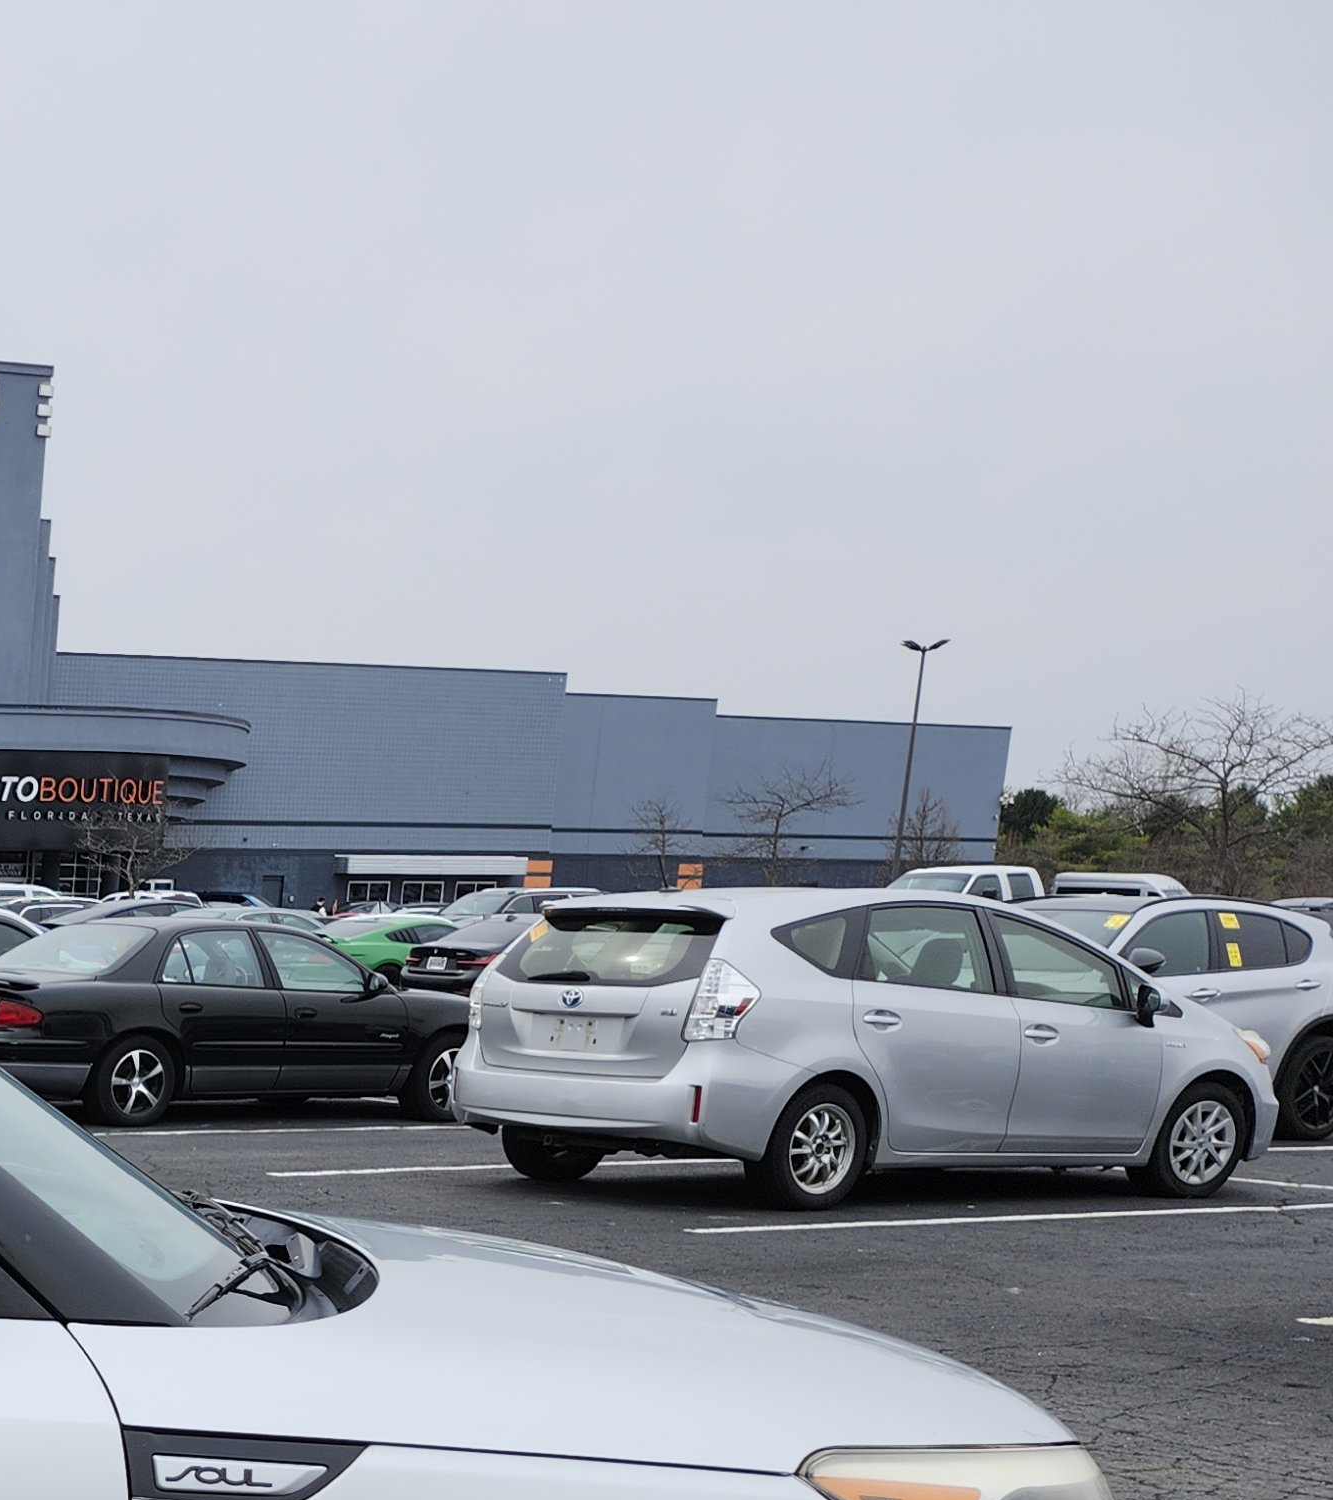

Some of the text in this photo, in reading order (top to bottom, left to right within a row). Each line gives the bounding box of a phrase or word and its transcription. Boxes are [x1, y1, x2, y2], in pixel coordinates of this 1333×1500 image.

[8, 809, 90, 822] FLORIDA
[117, 811, 162, 823] TEXAS
[164, 1465, 273, 1488] SOUL
